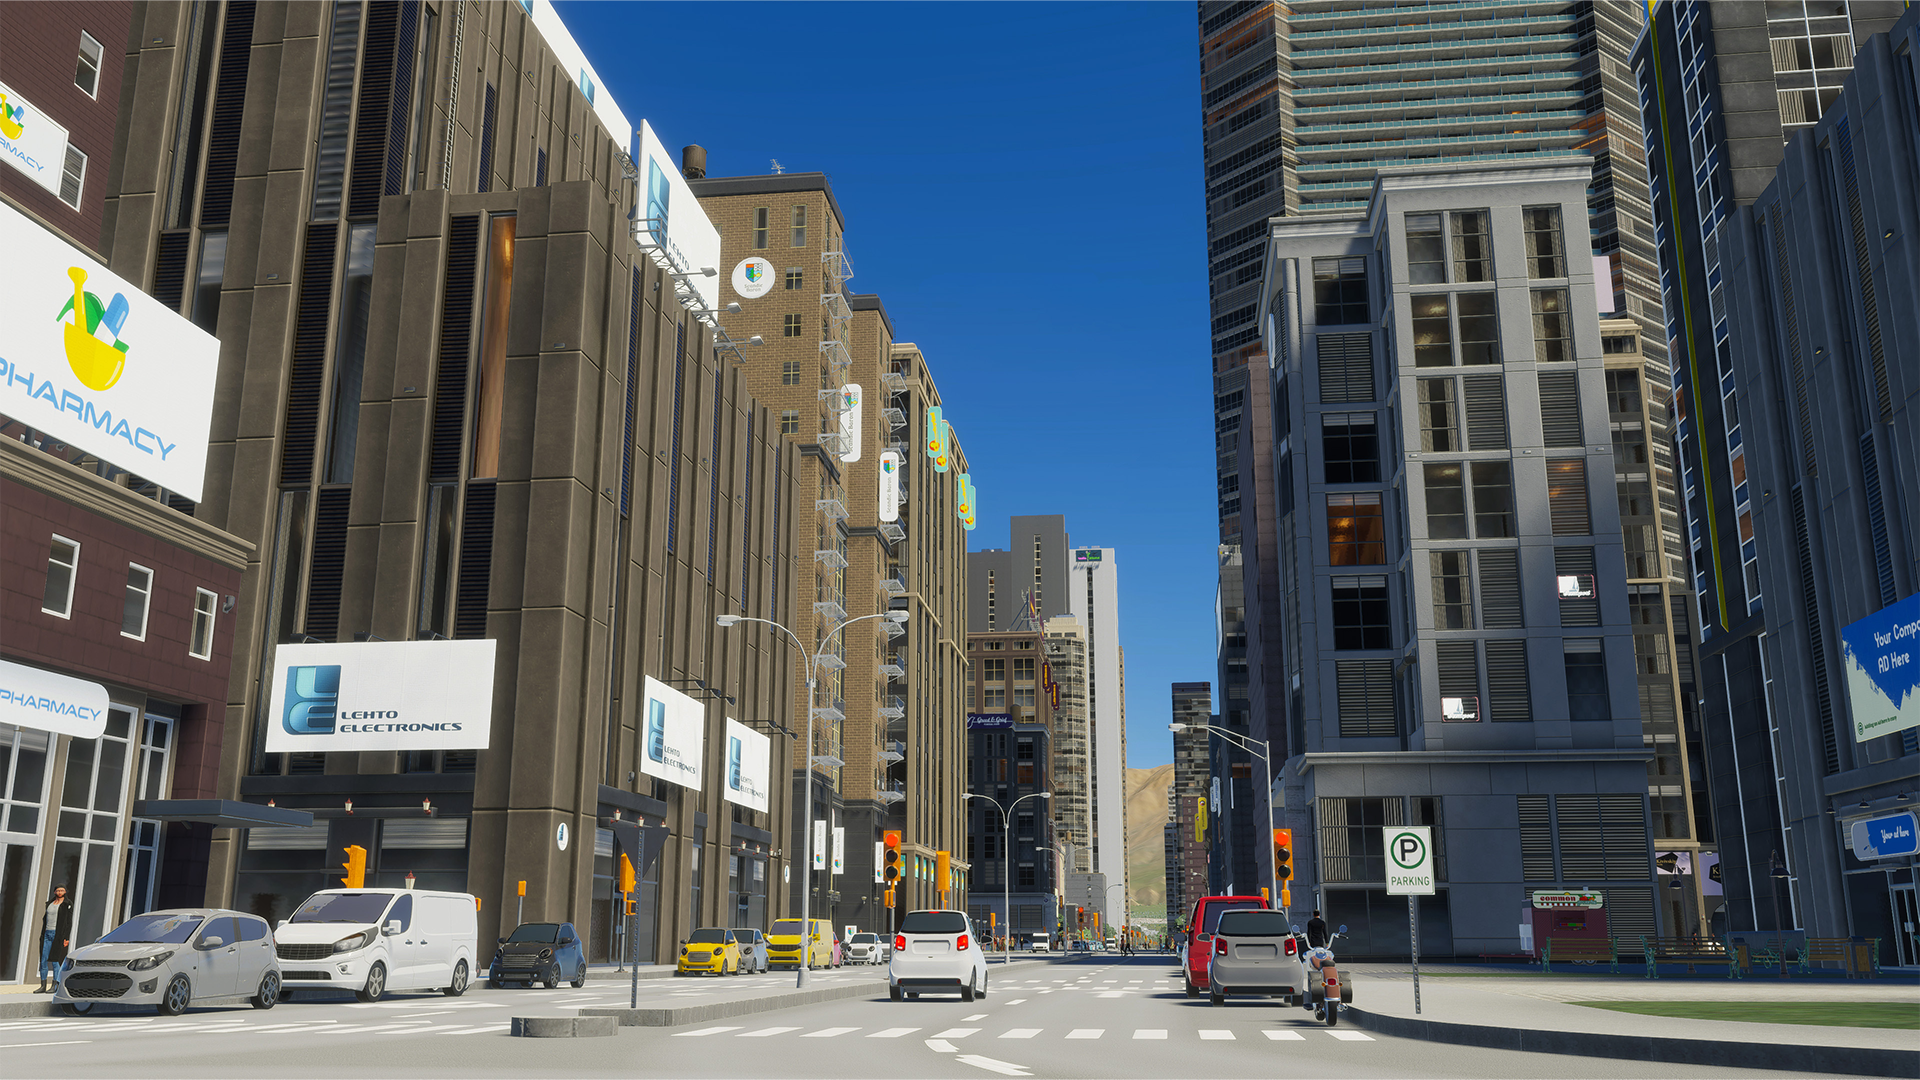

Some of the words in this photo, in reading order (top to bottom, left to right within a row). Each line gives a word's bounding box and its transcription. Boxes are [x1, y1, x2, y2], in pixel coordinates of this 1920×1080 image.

[668, 237, 690, 271] LEHTO
[1874, 632, 1891, 648] Your
[1878, 655, 1889, 674] AD
[1890, 651, 1910, 669] Here
[0, 688, 102, 721] PHARMACY
[341, 710, 398, 720] LEHTO
[340, 722, 462, 733] ELECTRONICS
[664, 745, 680, 758] LEHTO
[664, 756, 696, 775] ELECTRONICS
[740, 785, 764, 799] ELECTRONICS
[1400, 838, 1418, 862] P
[1391, 876, 1430, 886] PARKING
